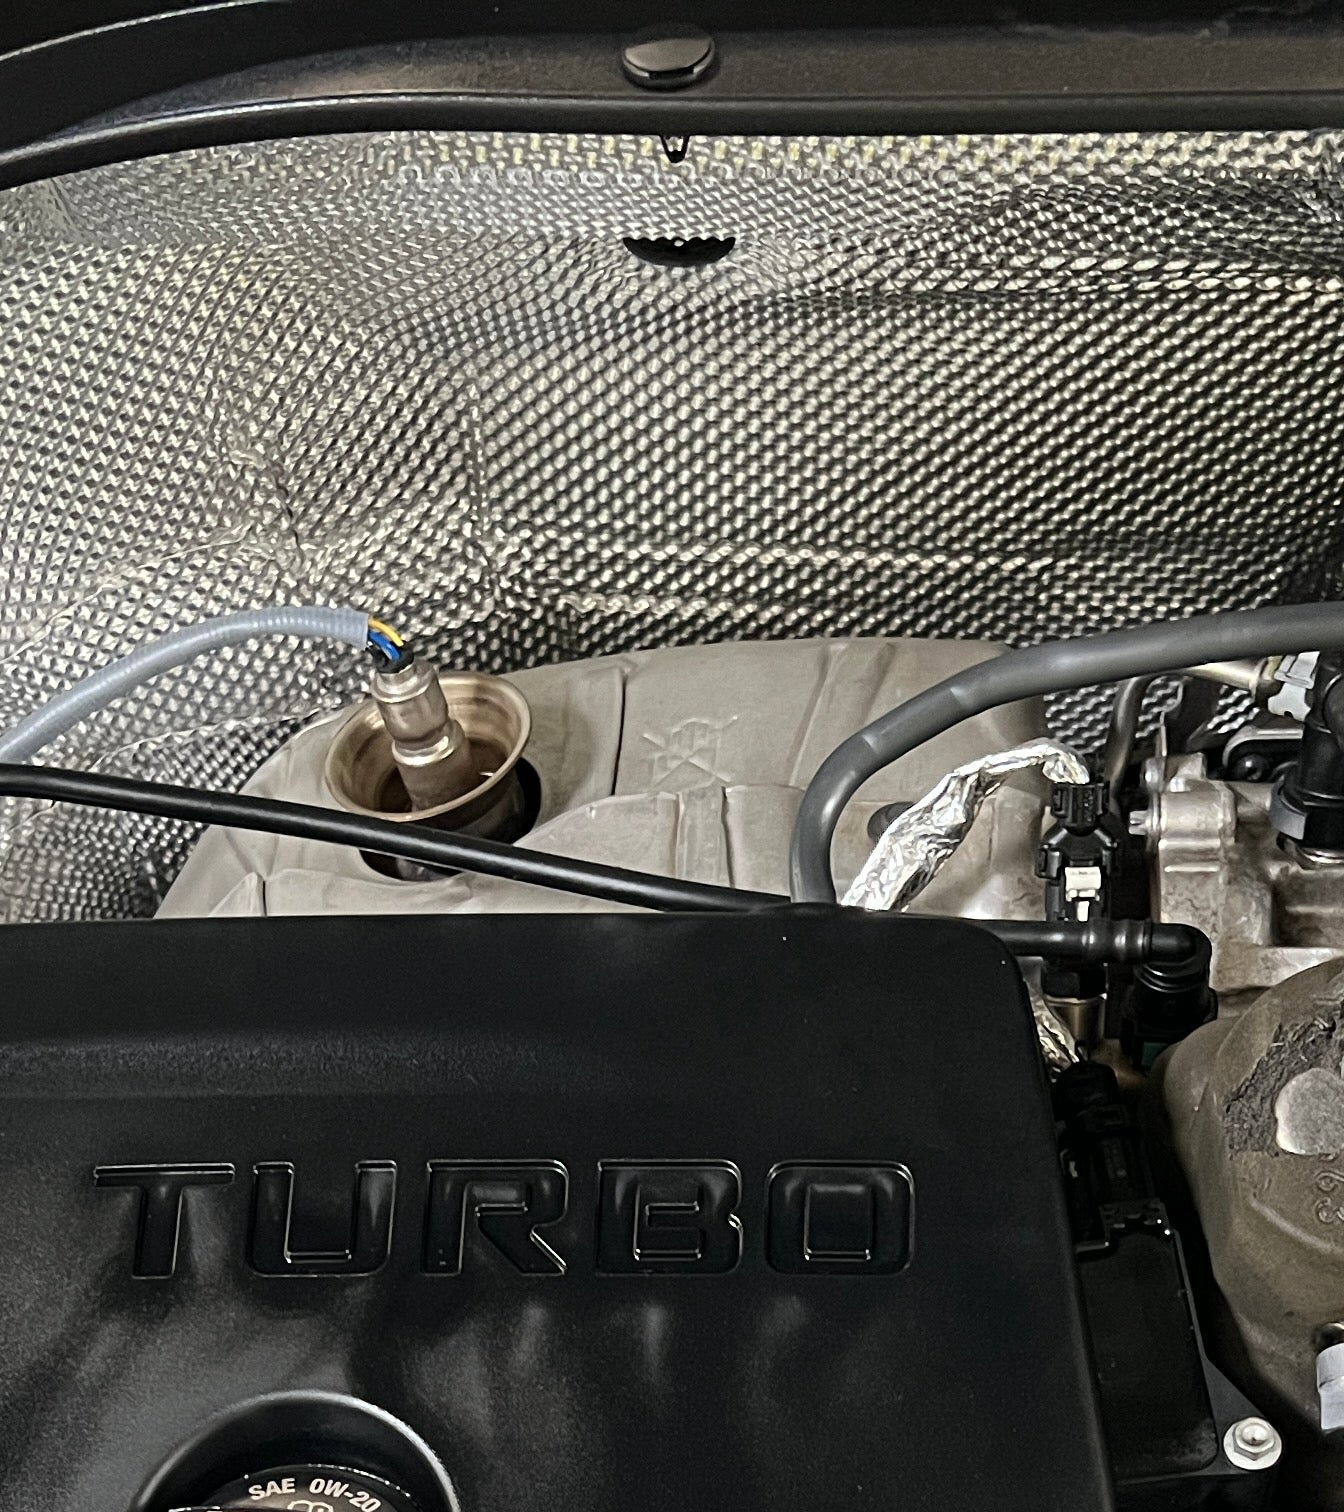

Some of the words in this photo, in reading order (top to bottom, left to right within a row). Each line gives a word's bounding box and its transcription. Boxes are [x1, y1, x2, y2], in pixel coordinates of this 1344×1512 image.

[92, 1158, 916, 1280] TURBO
[248, 1477, 296, 1500] SAE
[308, 1478, 382, 1512] 0W-20
